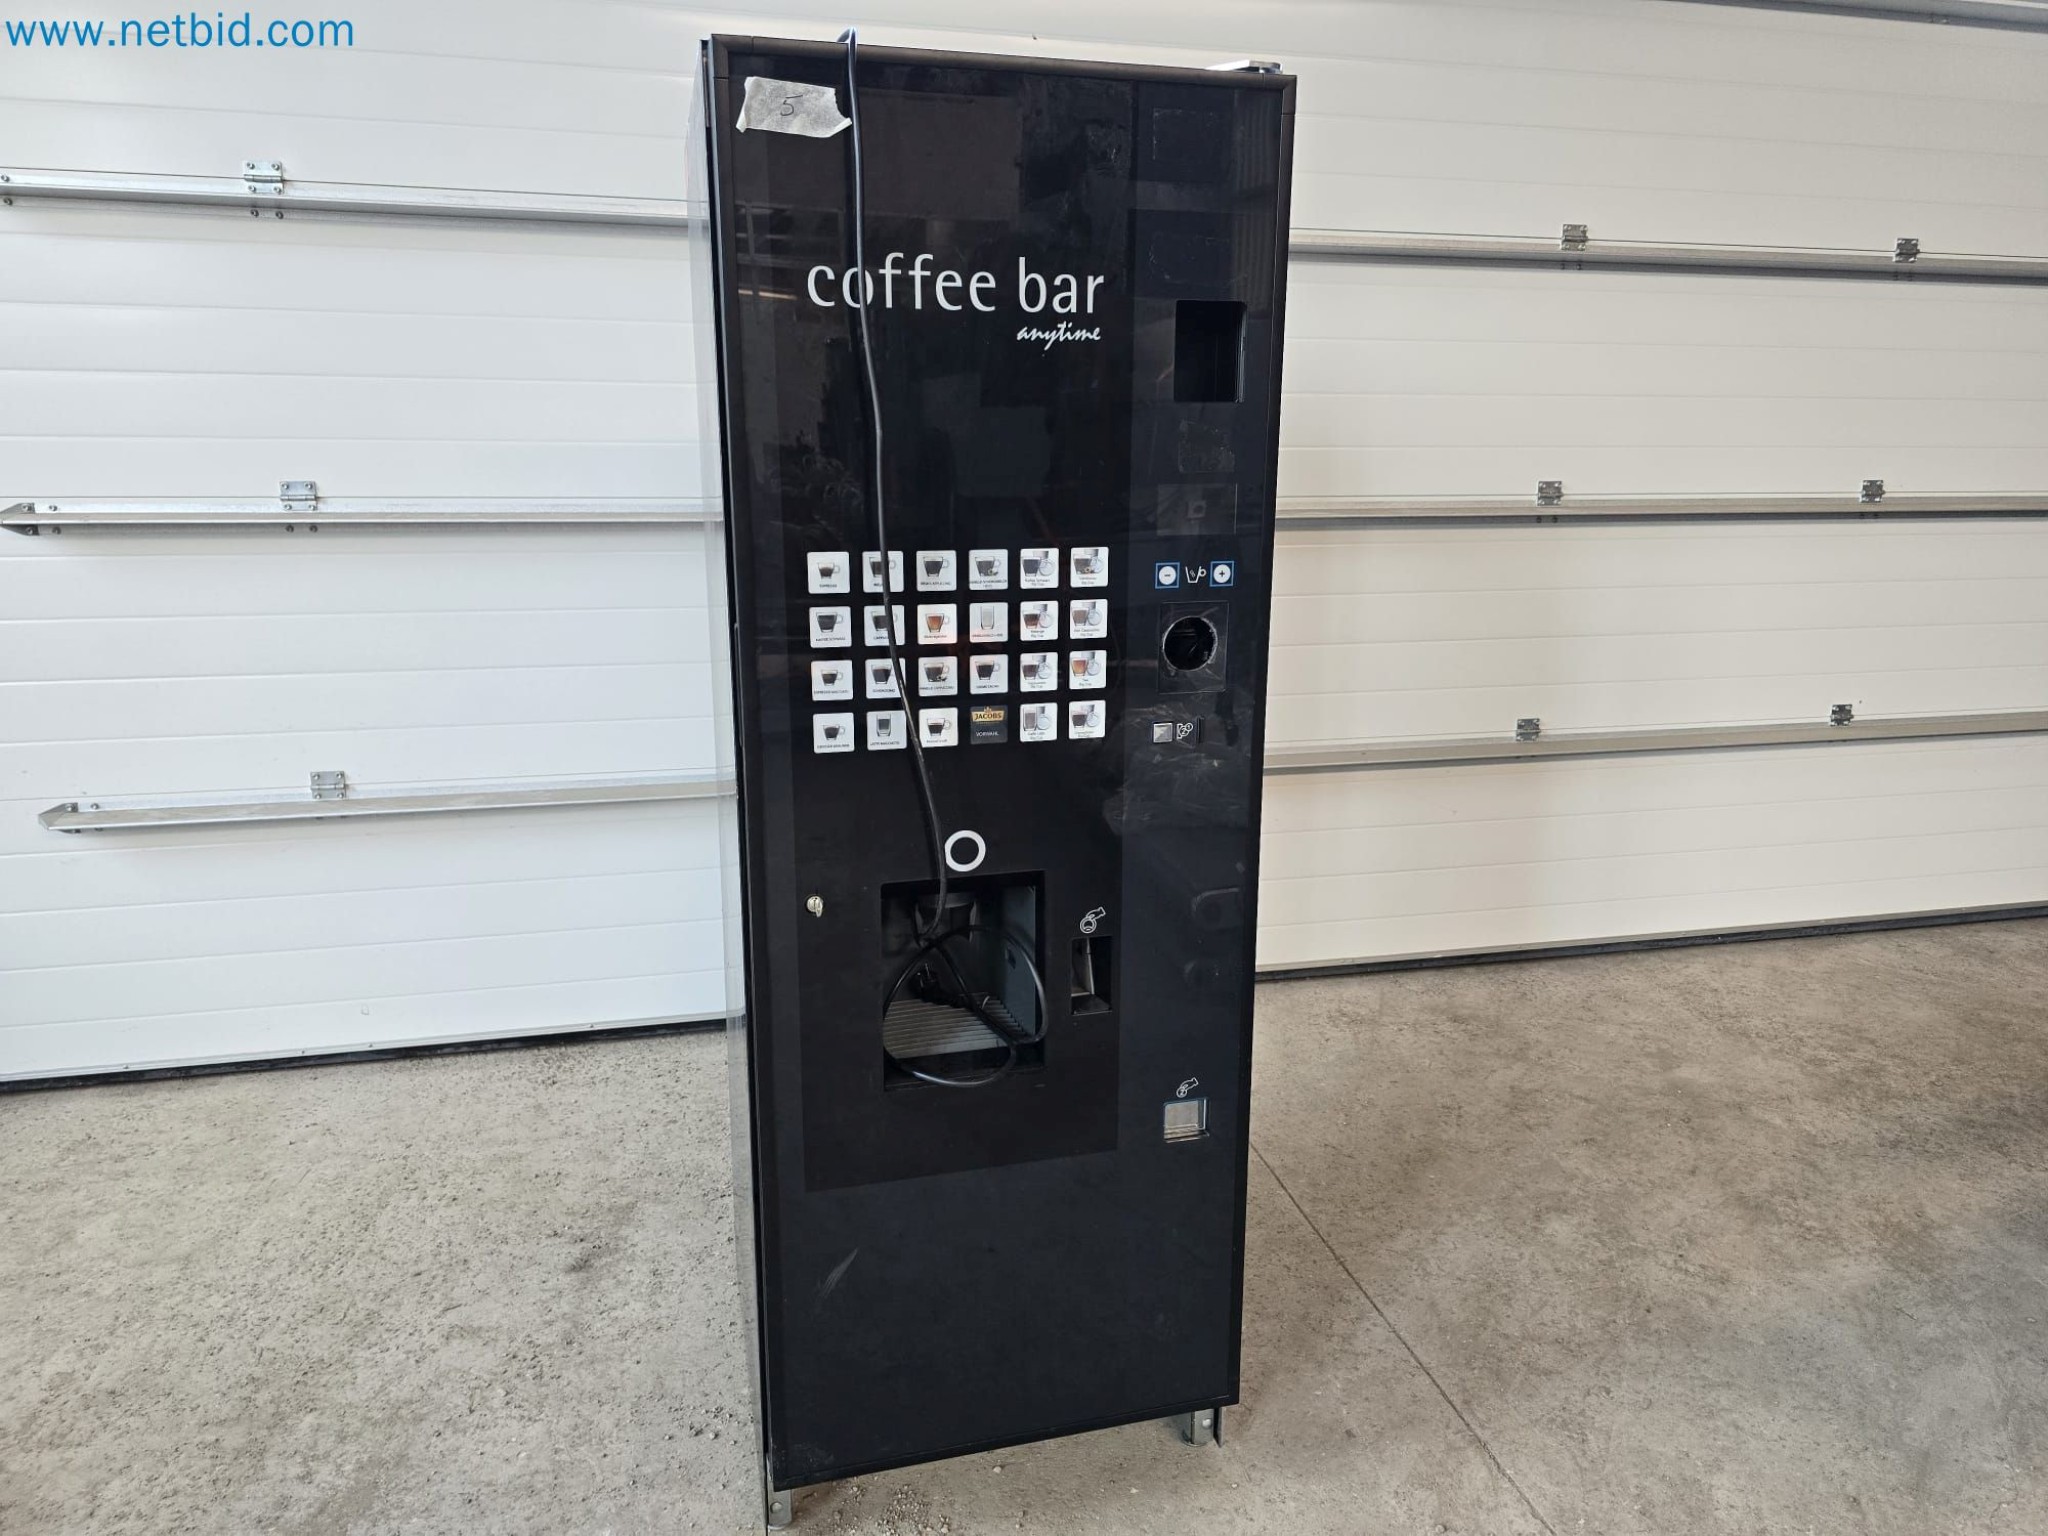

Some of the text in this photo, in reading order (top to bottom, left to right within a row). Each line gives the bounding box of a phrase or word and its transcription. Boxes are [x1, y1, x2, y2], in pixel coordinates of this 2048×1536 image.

[780, 94, 803, 116] 5
[806, 252, 1104, 314] coffee bar
[1016, 321, 1101, 350] anytime
[974, 712, 1003, 720] JACOBS
[975, 730, 1000, 738] VORWAHL
